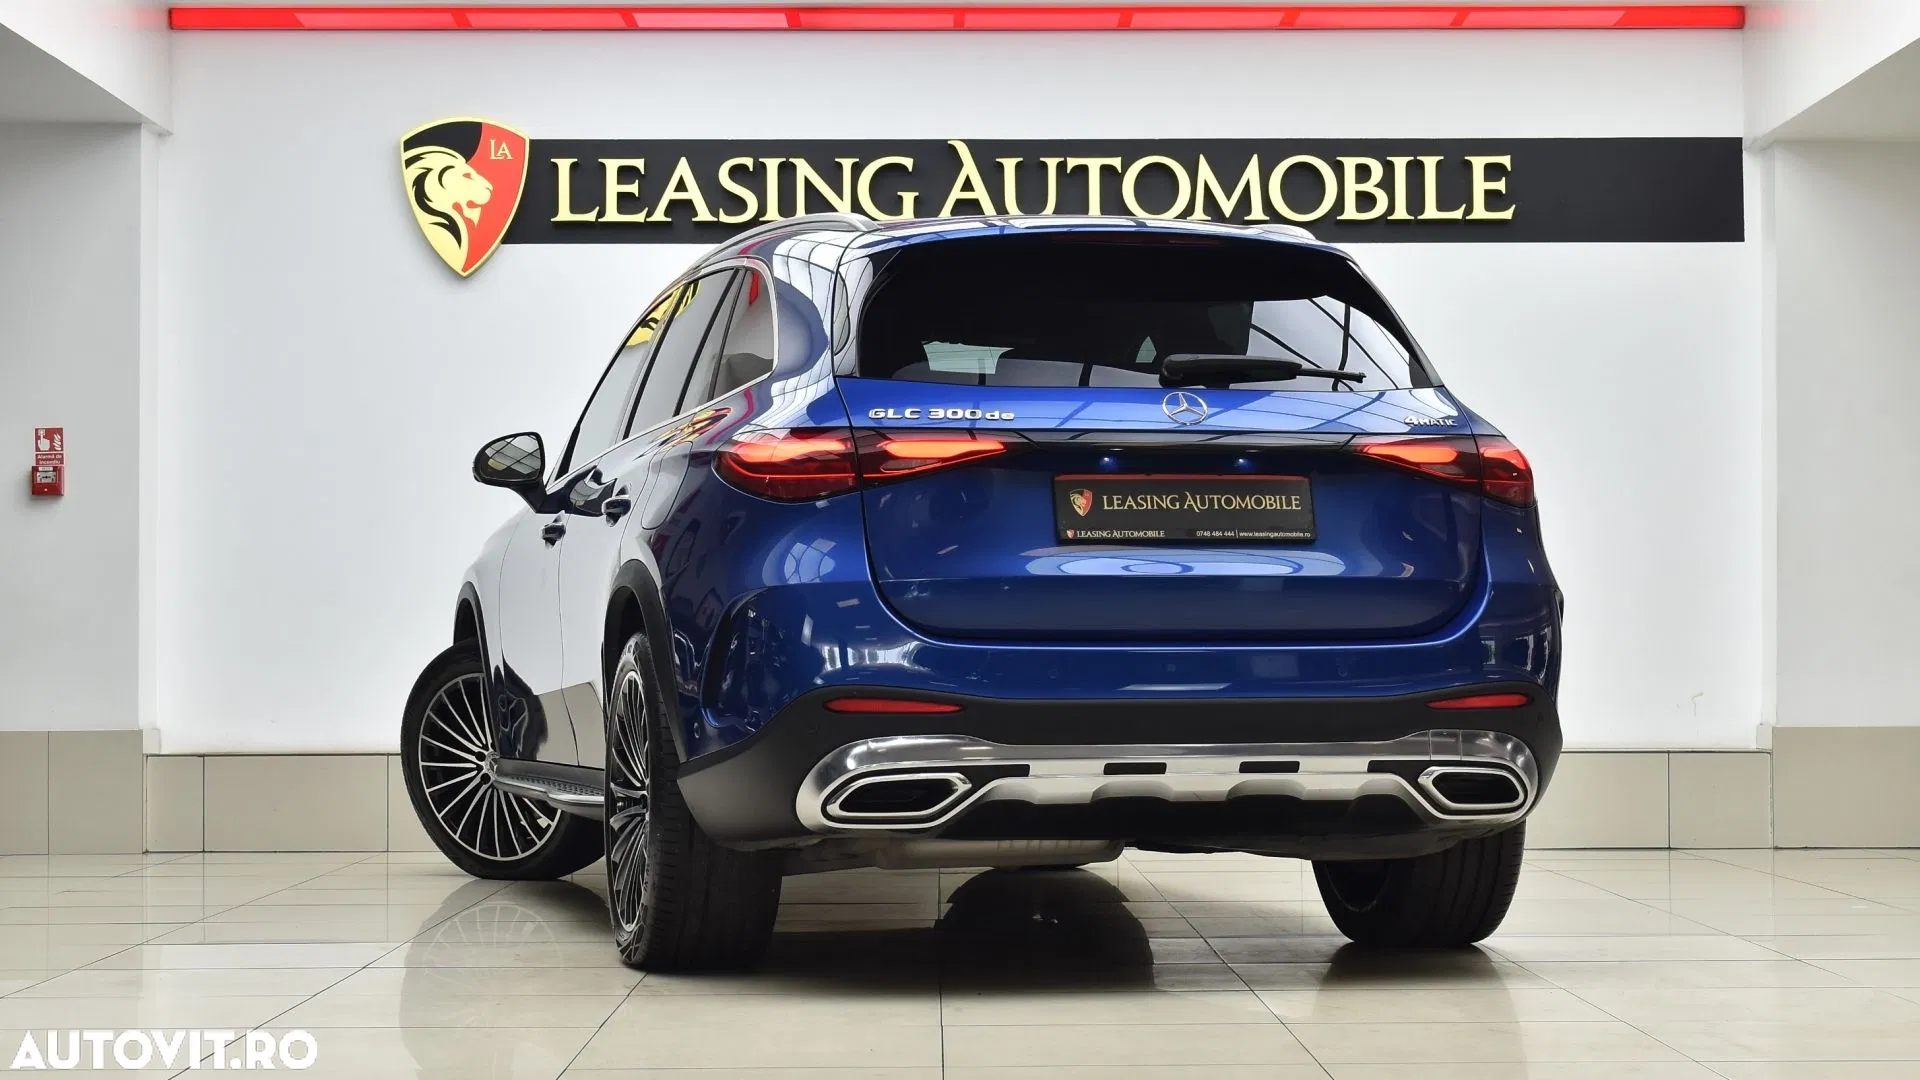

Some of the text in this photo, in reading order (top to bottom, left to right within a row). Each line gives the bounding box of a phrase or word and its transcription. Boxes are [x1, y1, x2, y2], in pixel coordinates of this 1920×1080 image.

[490, 139, 513, 160] LA
[550, 139, 1516, 224] LEASING AUTOMOBILE
[868, 408, 921, 420] GLC
[1103, 491, 1302, 512] LEASING AUTOMOBILE
[1077, 529, 1165, 539] LEASING AUTOMOBILE
